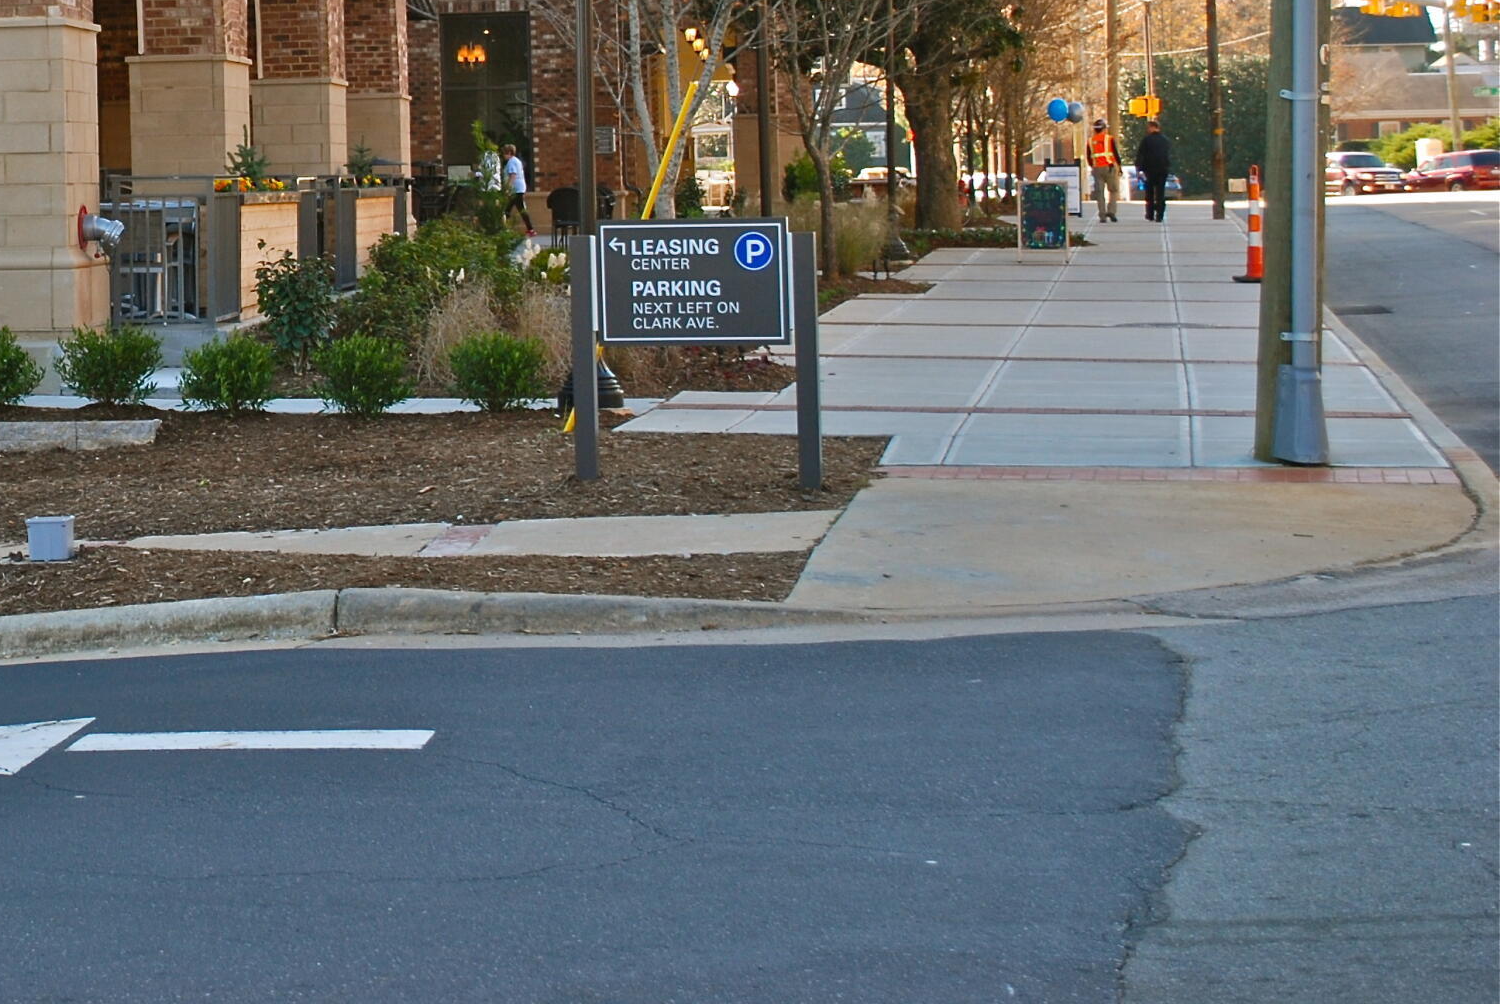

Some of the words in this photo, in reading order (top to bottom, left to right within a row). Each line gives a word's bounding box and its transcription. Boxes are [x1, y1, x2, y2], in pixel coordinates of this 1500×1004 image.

[631, 238, 719, 256] LEASING
[746, 240, 765, 263] P
[632, 258, 690, 270] CENTER
[632, 280, 721, 297] PARKING
[632, 302, 671, 314] NEXT
[678, 302, 713, 314] LEFT
[717, 302, 740, 314] ON
[632, 317, 681, 329] CLARK
[686, 317, 719, 329] AVE.
